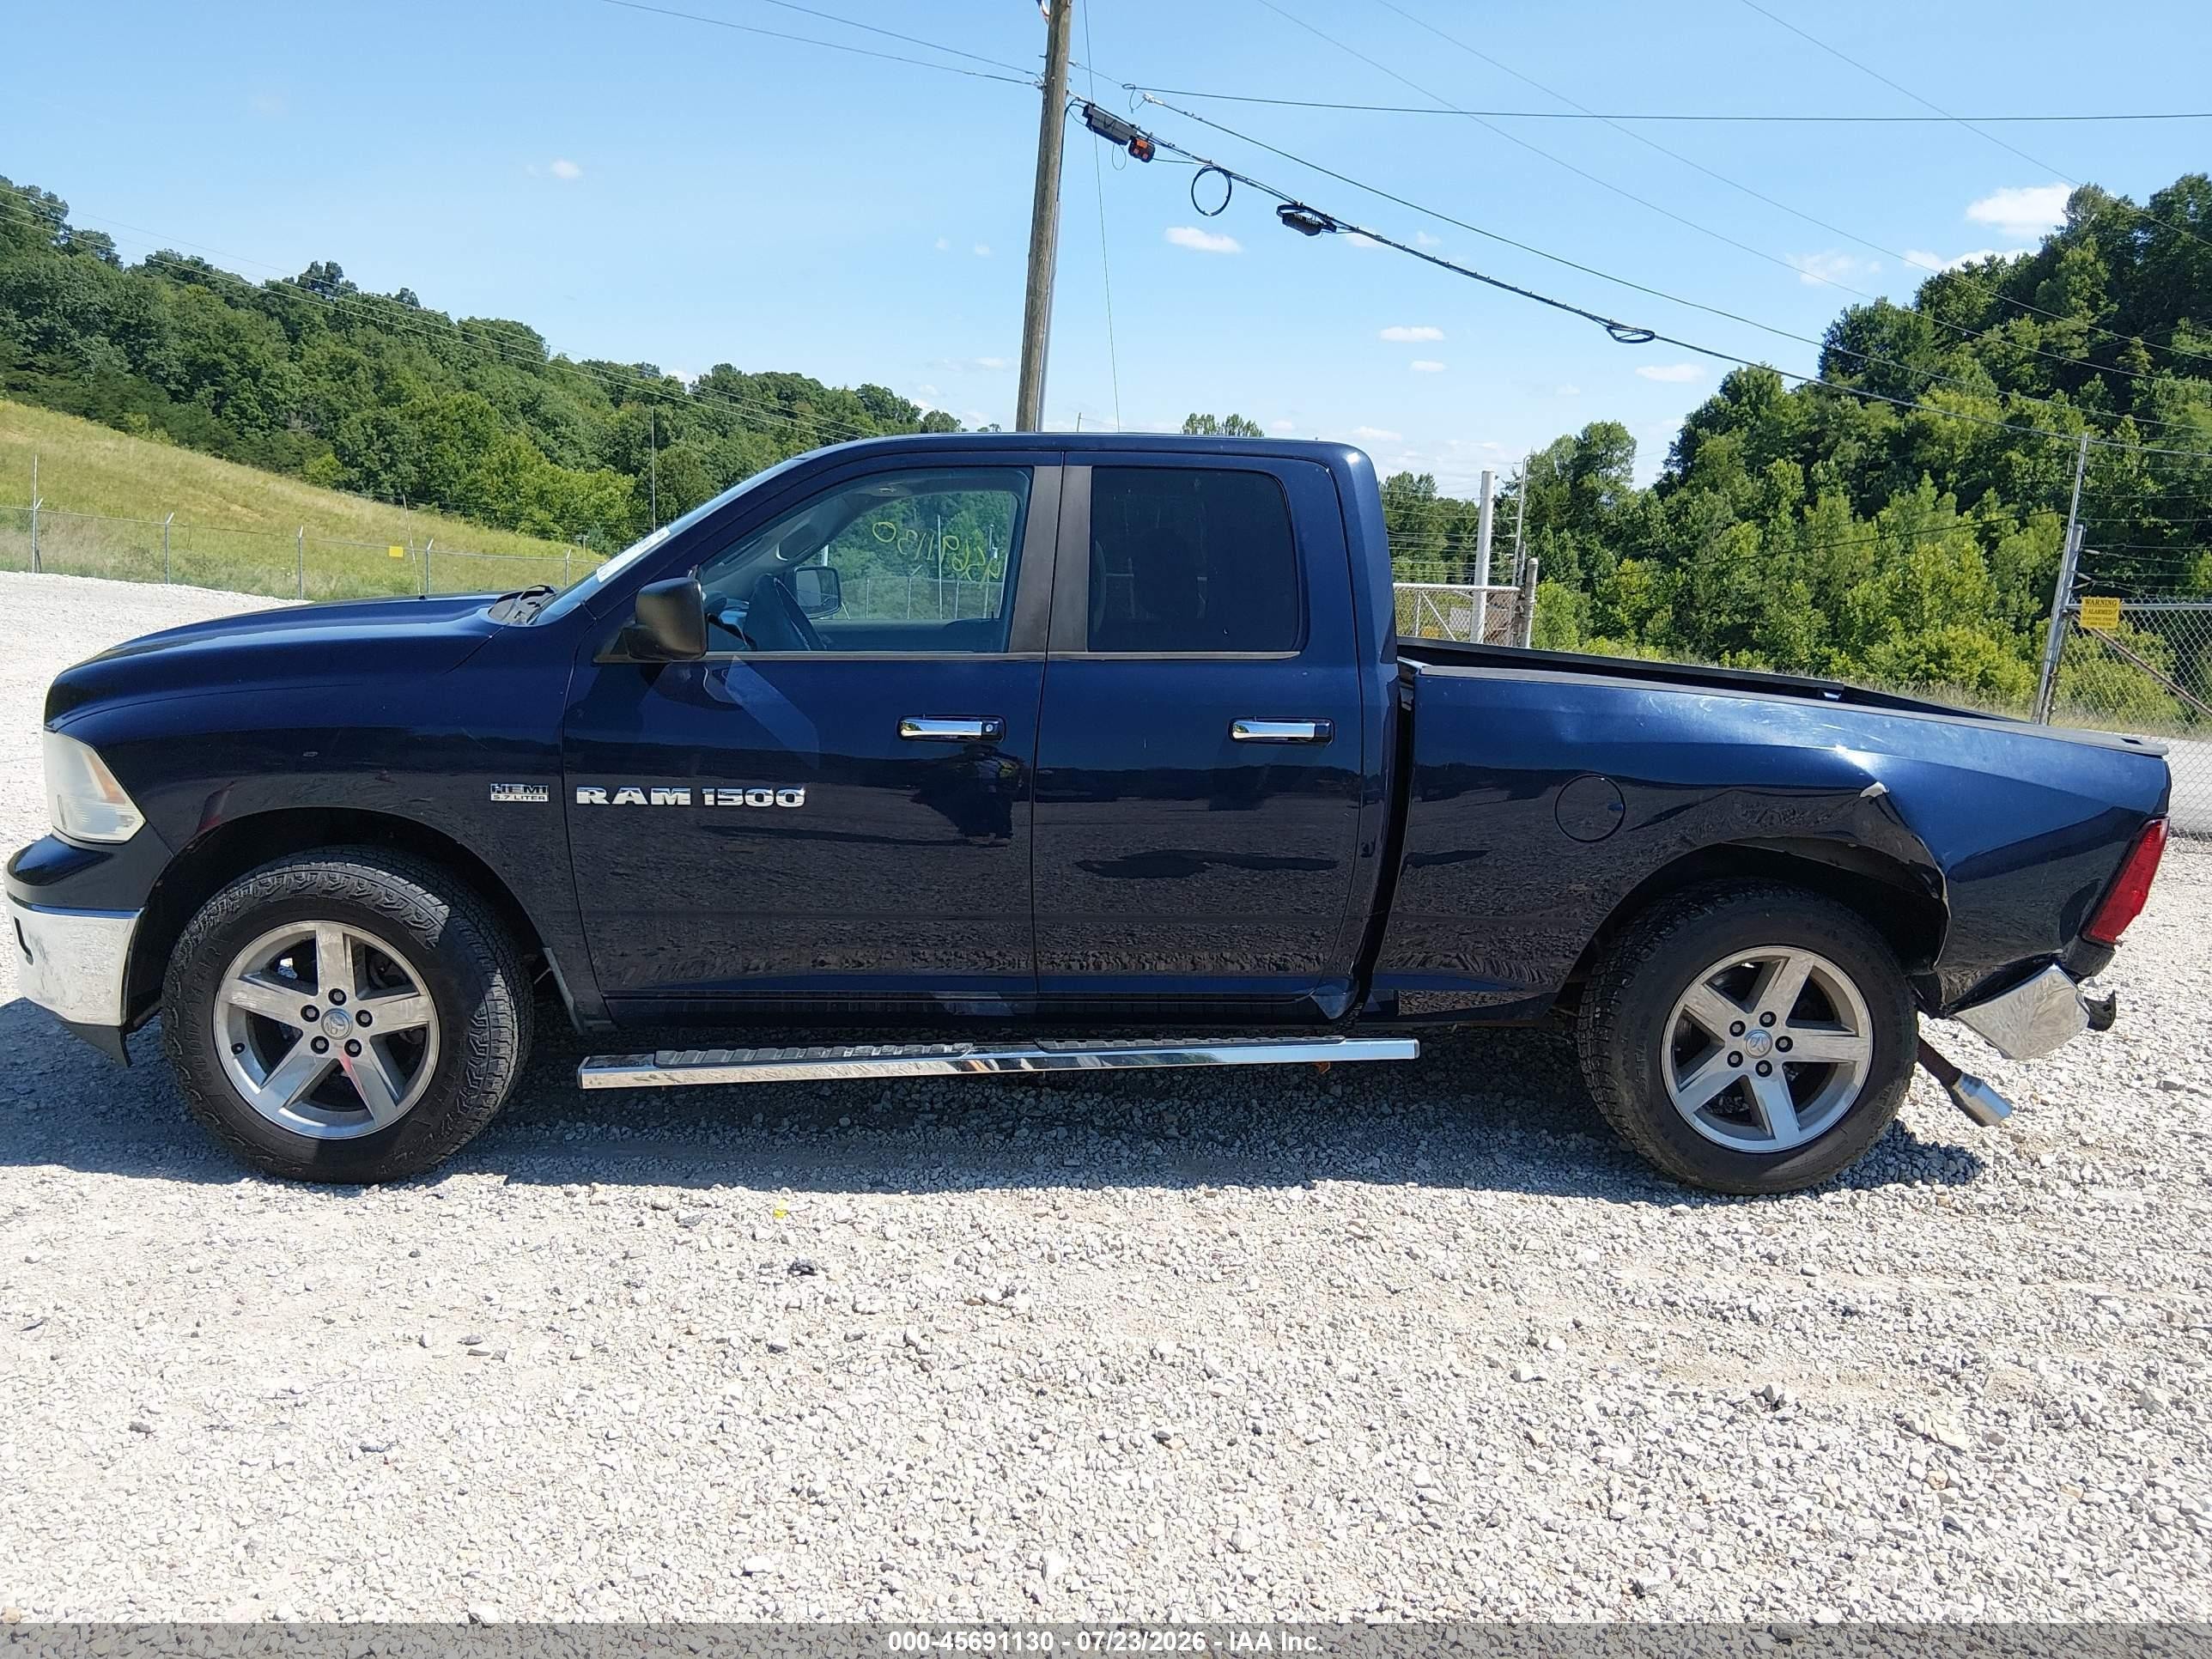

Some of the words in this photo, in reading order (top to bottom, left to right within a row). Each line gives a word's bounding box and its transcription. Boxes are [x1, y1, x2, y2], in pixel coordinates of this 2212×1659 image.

[491, 783, 548, 793] HEMI
[576, 787, 691, 805] RAM
[702, 787, 805, 807] 1500
